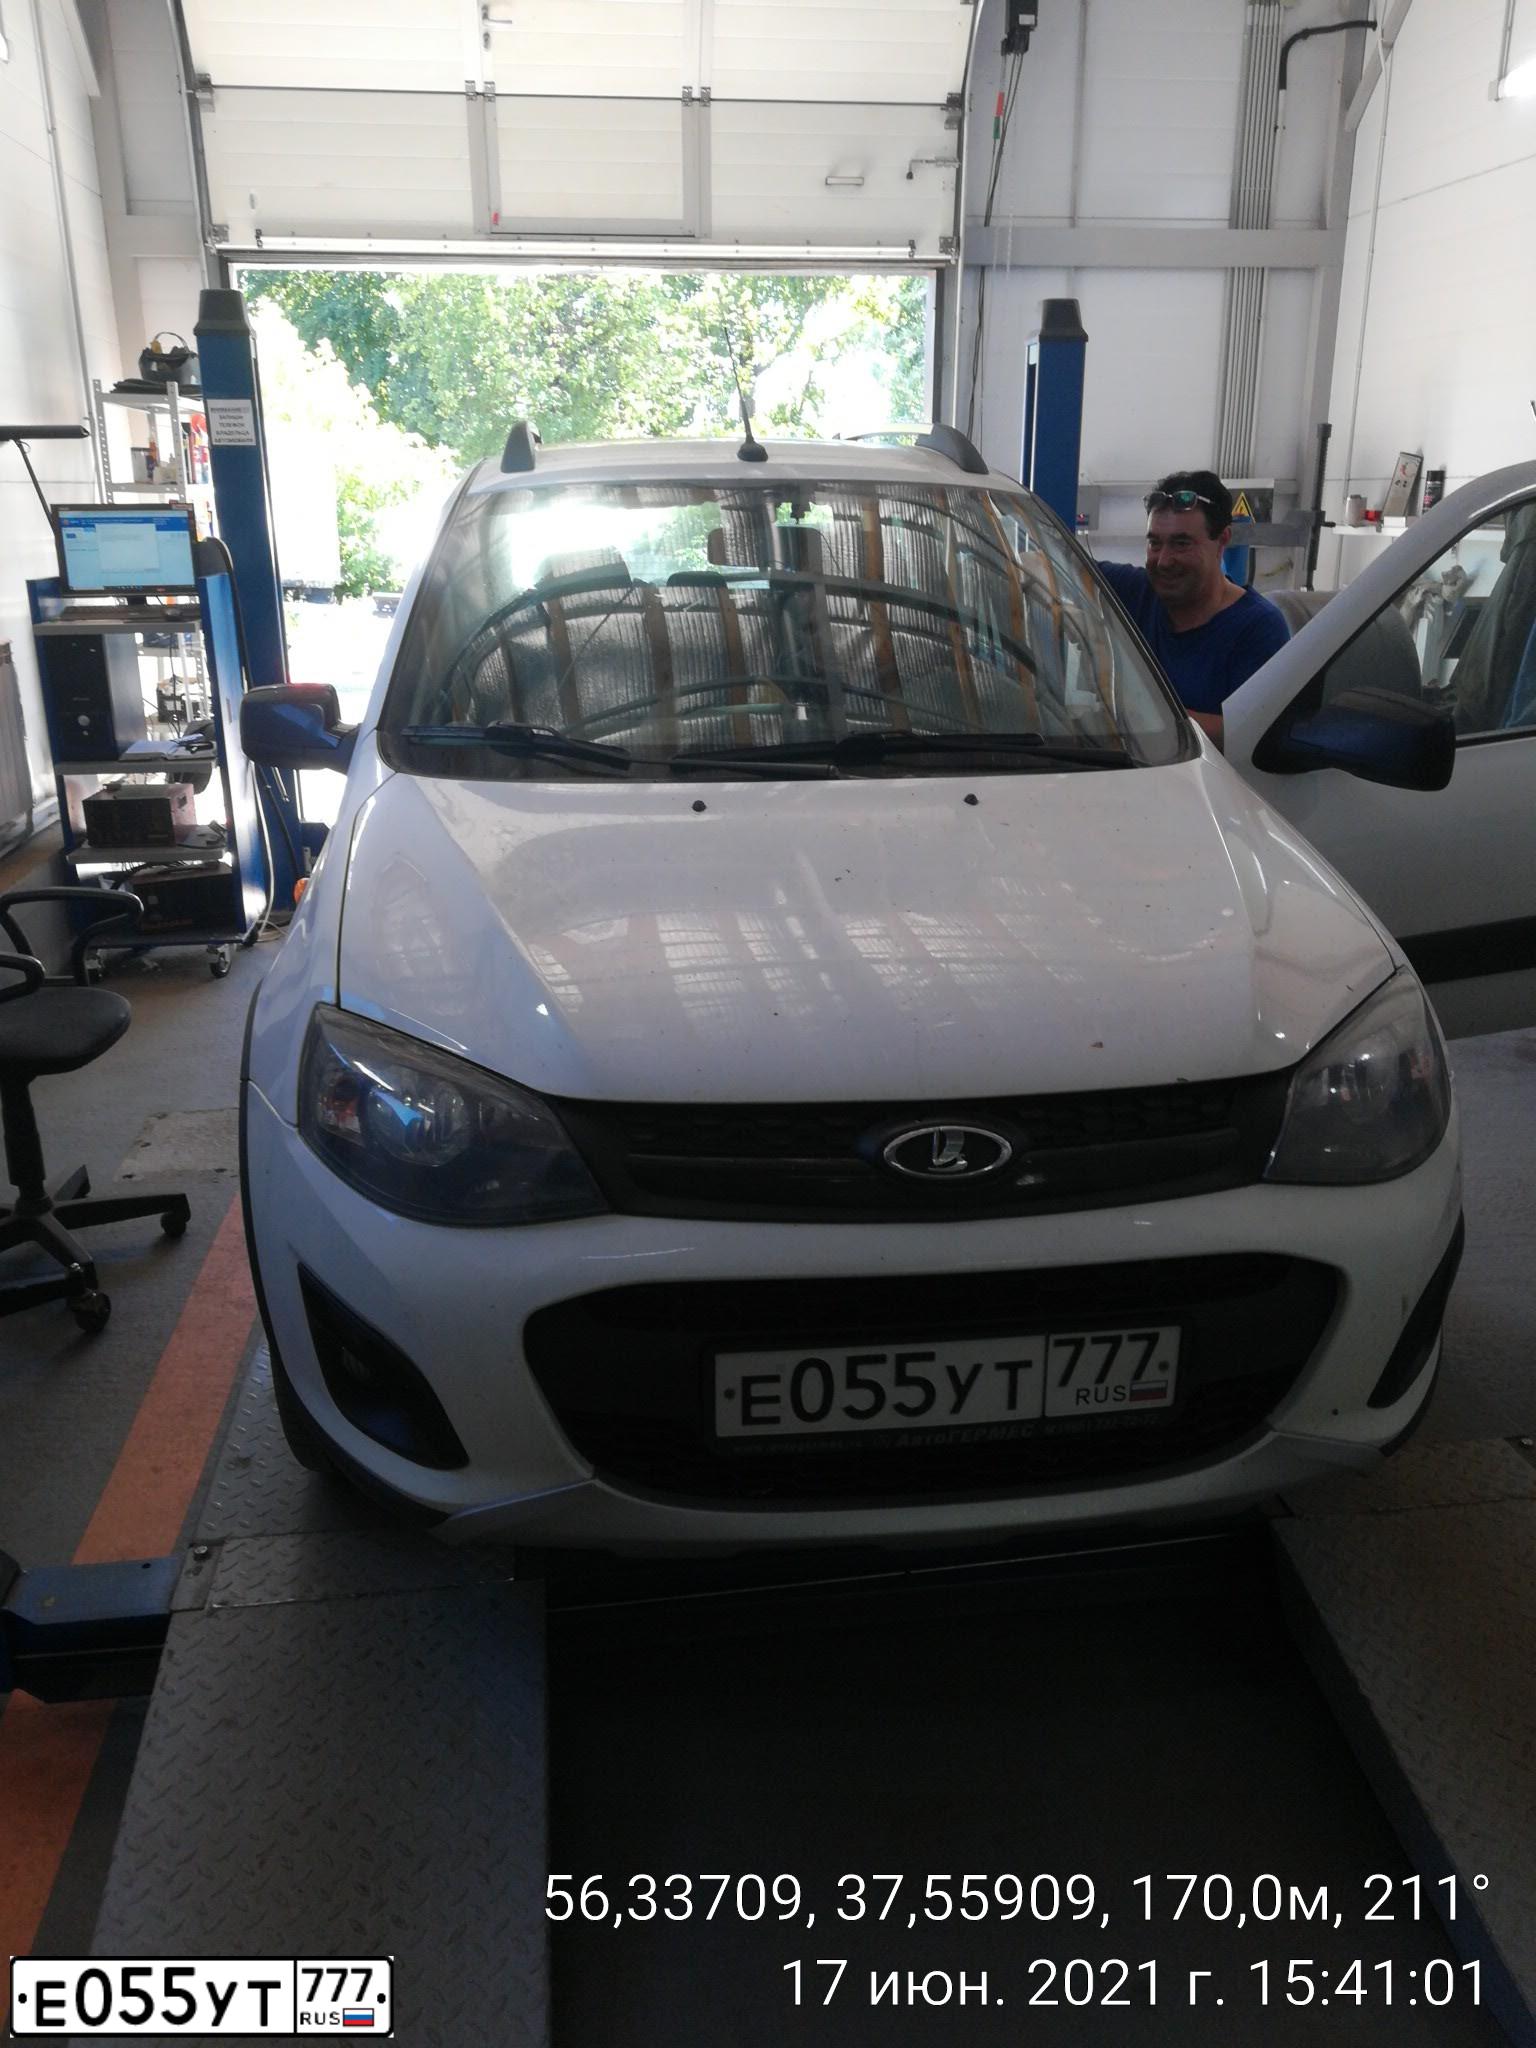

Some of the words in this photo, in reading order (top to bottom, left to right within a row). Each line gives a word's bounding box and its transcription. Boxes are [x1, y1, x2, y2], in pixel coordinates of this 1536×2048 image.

[741, 1351, 1033, 1427] Е055УТ
[1053, 1331, 1160, 1388] 777
[1075, 1384, 1127, 1406] RUS
